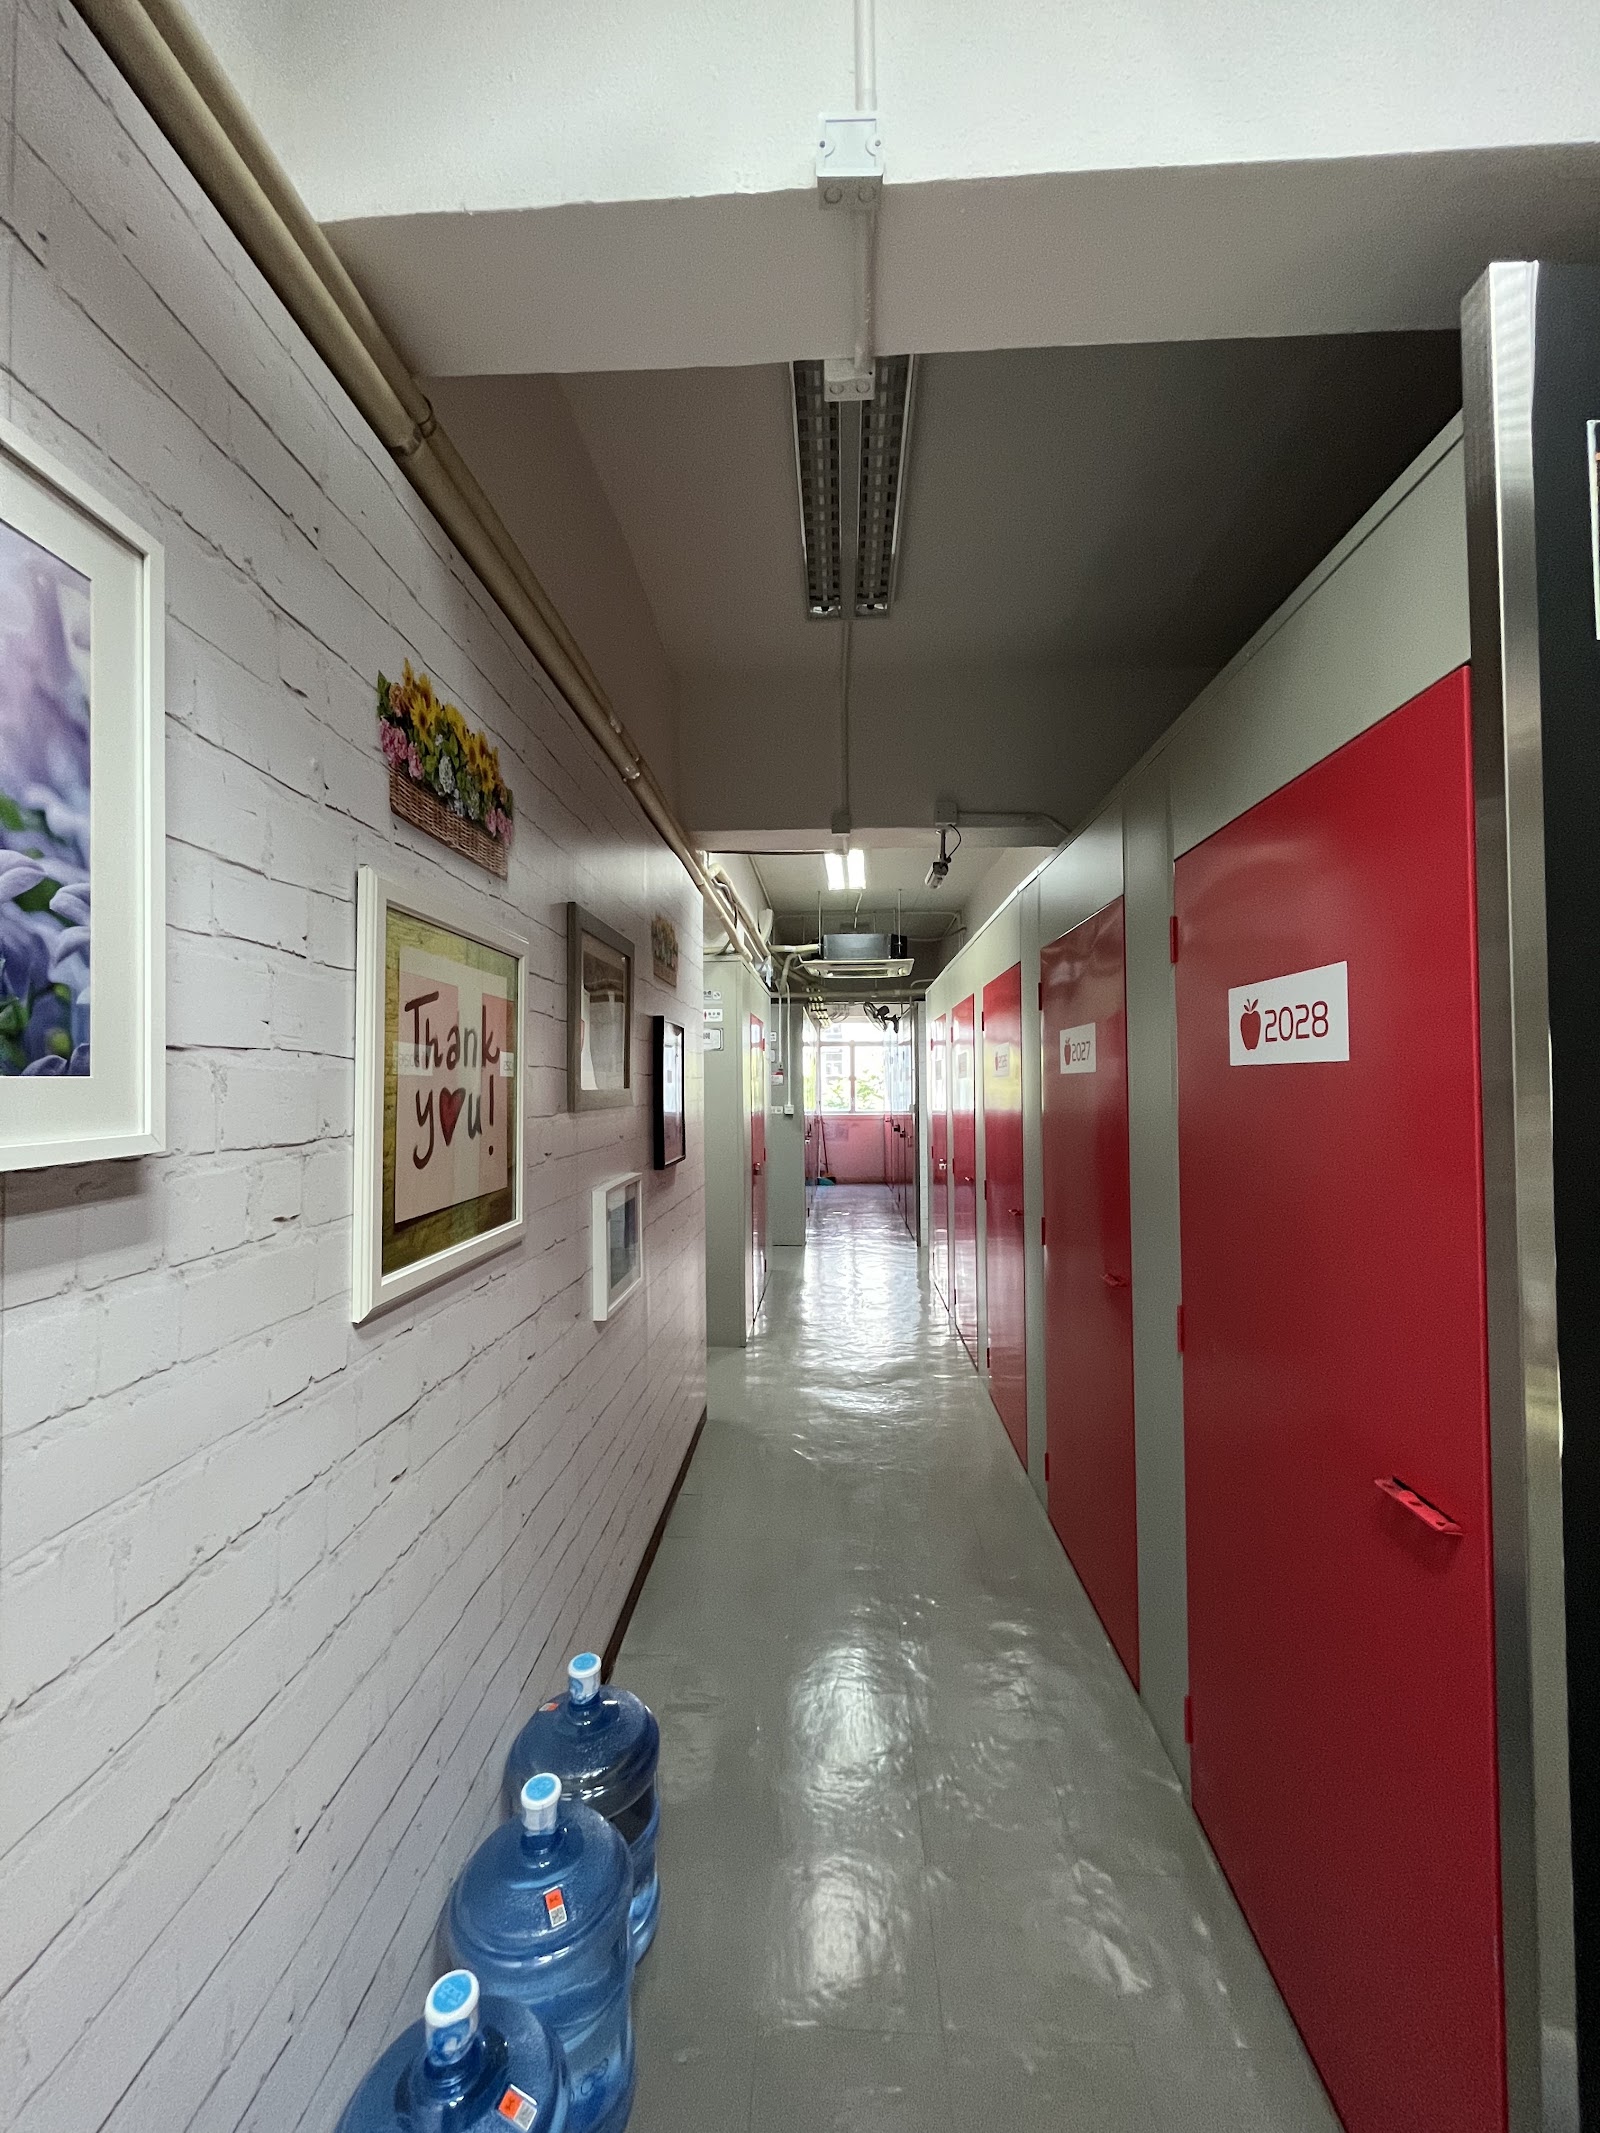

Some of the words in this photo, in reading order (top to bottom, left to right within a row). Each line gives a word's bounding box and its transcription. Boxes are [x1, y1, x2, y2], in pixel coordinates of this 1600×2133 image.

[404, 991, 500, 1070] Thank
[1264, 1000, 1329, 1043] 2028
[1071, 1041, 1091, 1062] 2027
